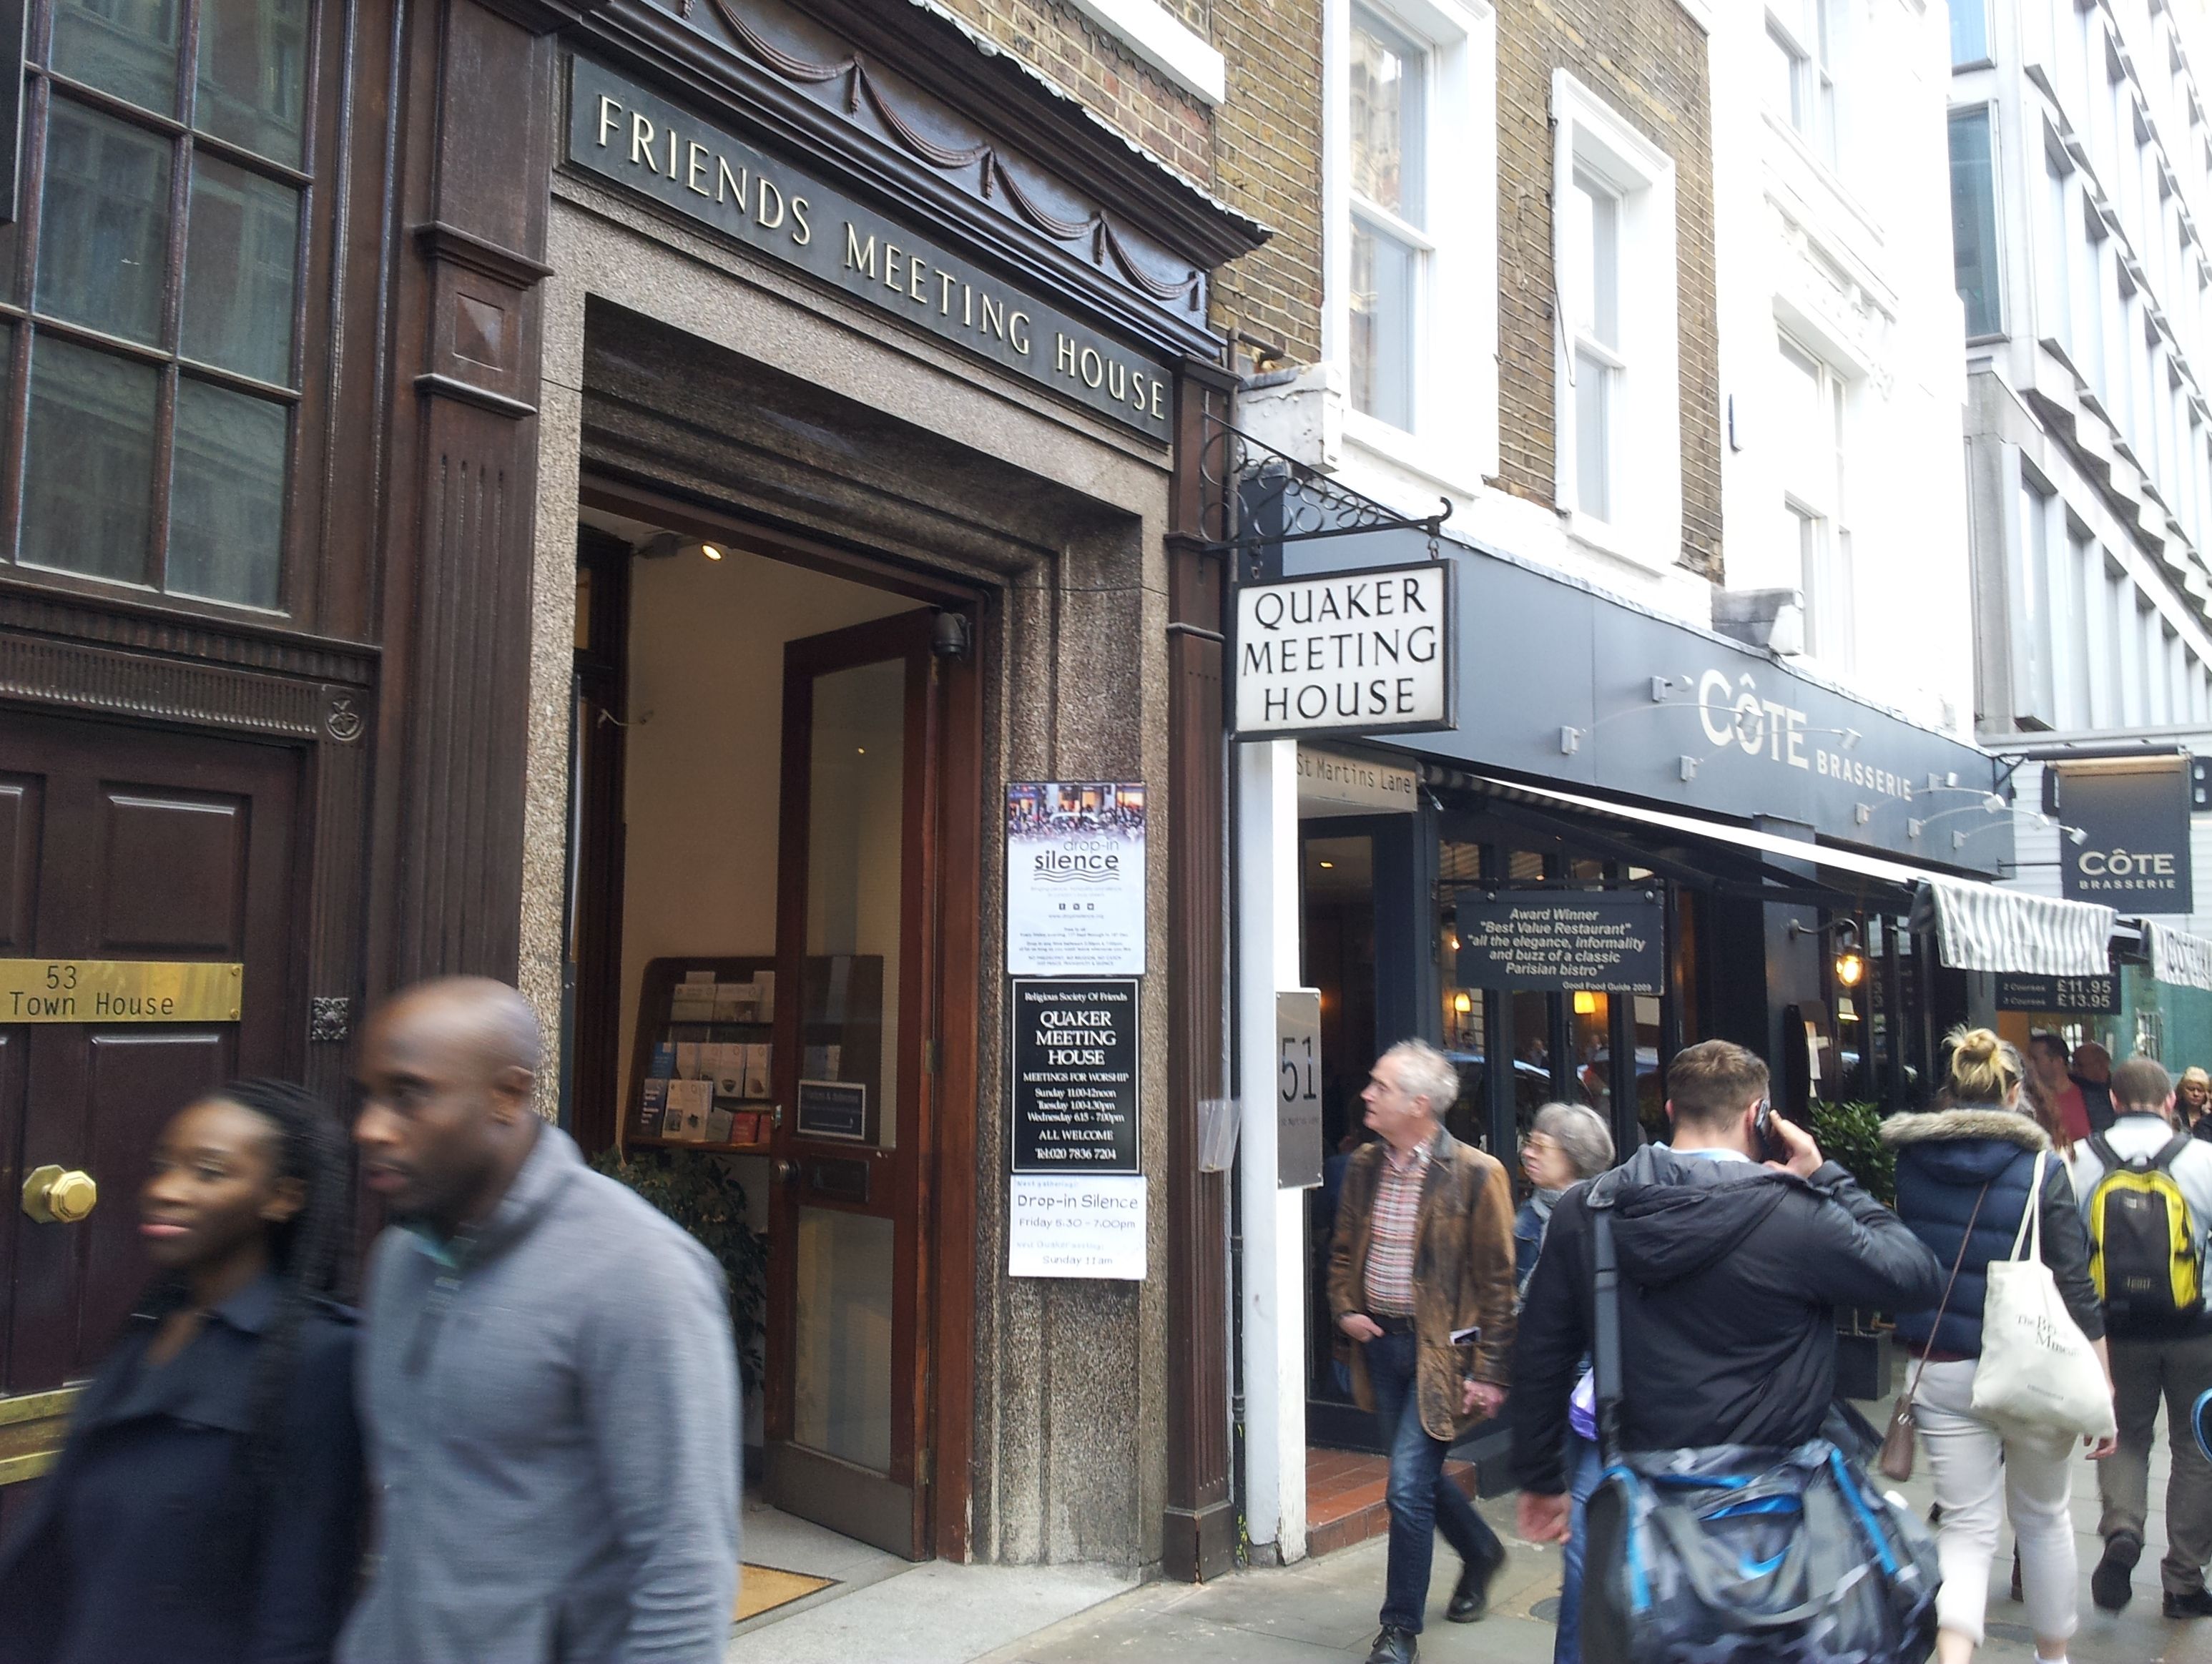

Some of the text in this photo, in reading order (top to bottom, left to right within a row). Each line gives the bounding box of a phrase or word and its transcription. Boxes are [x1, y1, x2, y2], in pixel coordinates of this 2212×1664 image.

[596, 93, 1165, 420] FRIENDS MEETING HOUSE
[1254, 578, 1427, 630] QUAKER
[1243, 626, 1437, 676] MEETING
[1264, 678, 1415, 721] HOUSE
[1699, 669, 1913, 802] CÔTE BRASSERIE
[1317, 758, 1375, 788] Martins
[1380, 769, 1411, 794] Lane
[1063, 840, 1119, 853] drop-in
[1035, 850, 1119, 870] silence
[2078, 847, 2176, 875] CÔTE
[2079, 879, 2176, 890] BRASSERIE
[1510, 908, 1600, 921] Award Winner
[1480, 921, 1632, 936] "Best Value Restaurant"
[1468, 935, 1646, 952] "all the elegance, informality
[1490, 949, 1621, 963] and buzz of a classic
[46, 965, 77, 990] 53
[1505, 963, 1604, 977] Parisian bistro"
[2057, 978, 2111, 994] £11.95
[9, 991, 174, 1015] Town House
[1040, 1010, 1112, 1028] QUAKER
[1036, 1030, 1116, 1046] MEETING
[1048, 1050, 1106, 1065] HOUSE
[1023, 1072, 1129, 1082] MEETINGS FOR WORSHIP
[1282, 1036, 1317, 1103] 51
[1035, 1088, 1065, 1100] Sunday
[1036, 1100, 1068, 1112] Tuesday
[1027, 1112, 1073, 1124] Wednesday
[1038, 1130, 1114, 1141] ALL WELCOME
[1068, 1148, 1093, 1160] 7836
[1094, 1148, 1116, 1160] 7204
[1018, 1193, 1139, 1210] Drop-in Silence
[1019, 1218, 1052, 1229] Friday
[1043, 1255, 1081, 1267] Sunday
